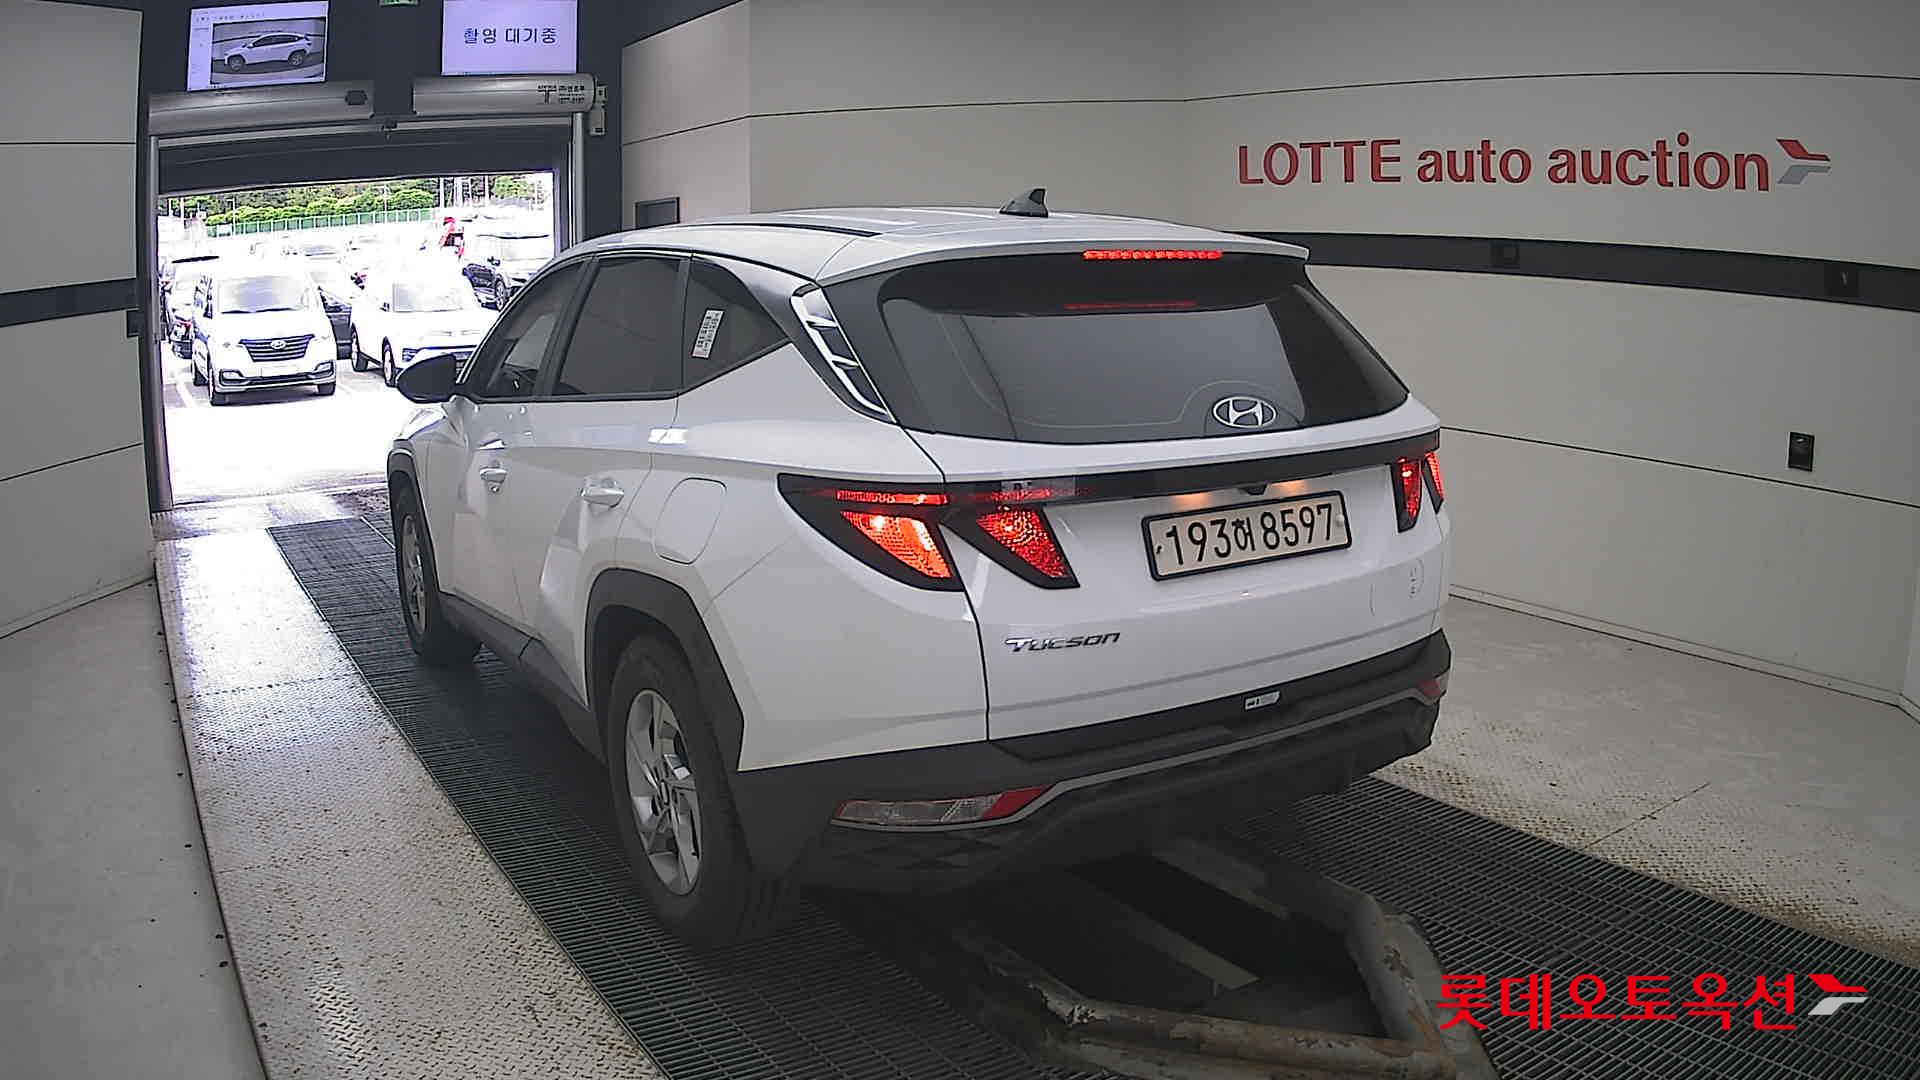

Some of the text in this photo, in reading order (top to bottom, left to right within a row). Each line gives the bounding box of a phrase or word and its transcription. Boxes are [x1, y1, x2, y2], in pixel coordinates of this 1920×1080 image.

[505, 27, 557, 45] 대기중
[1238, 132, 1770, 191] LOTTE auto auction
[1166, 503, 1333, 565] 193허8597
